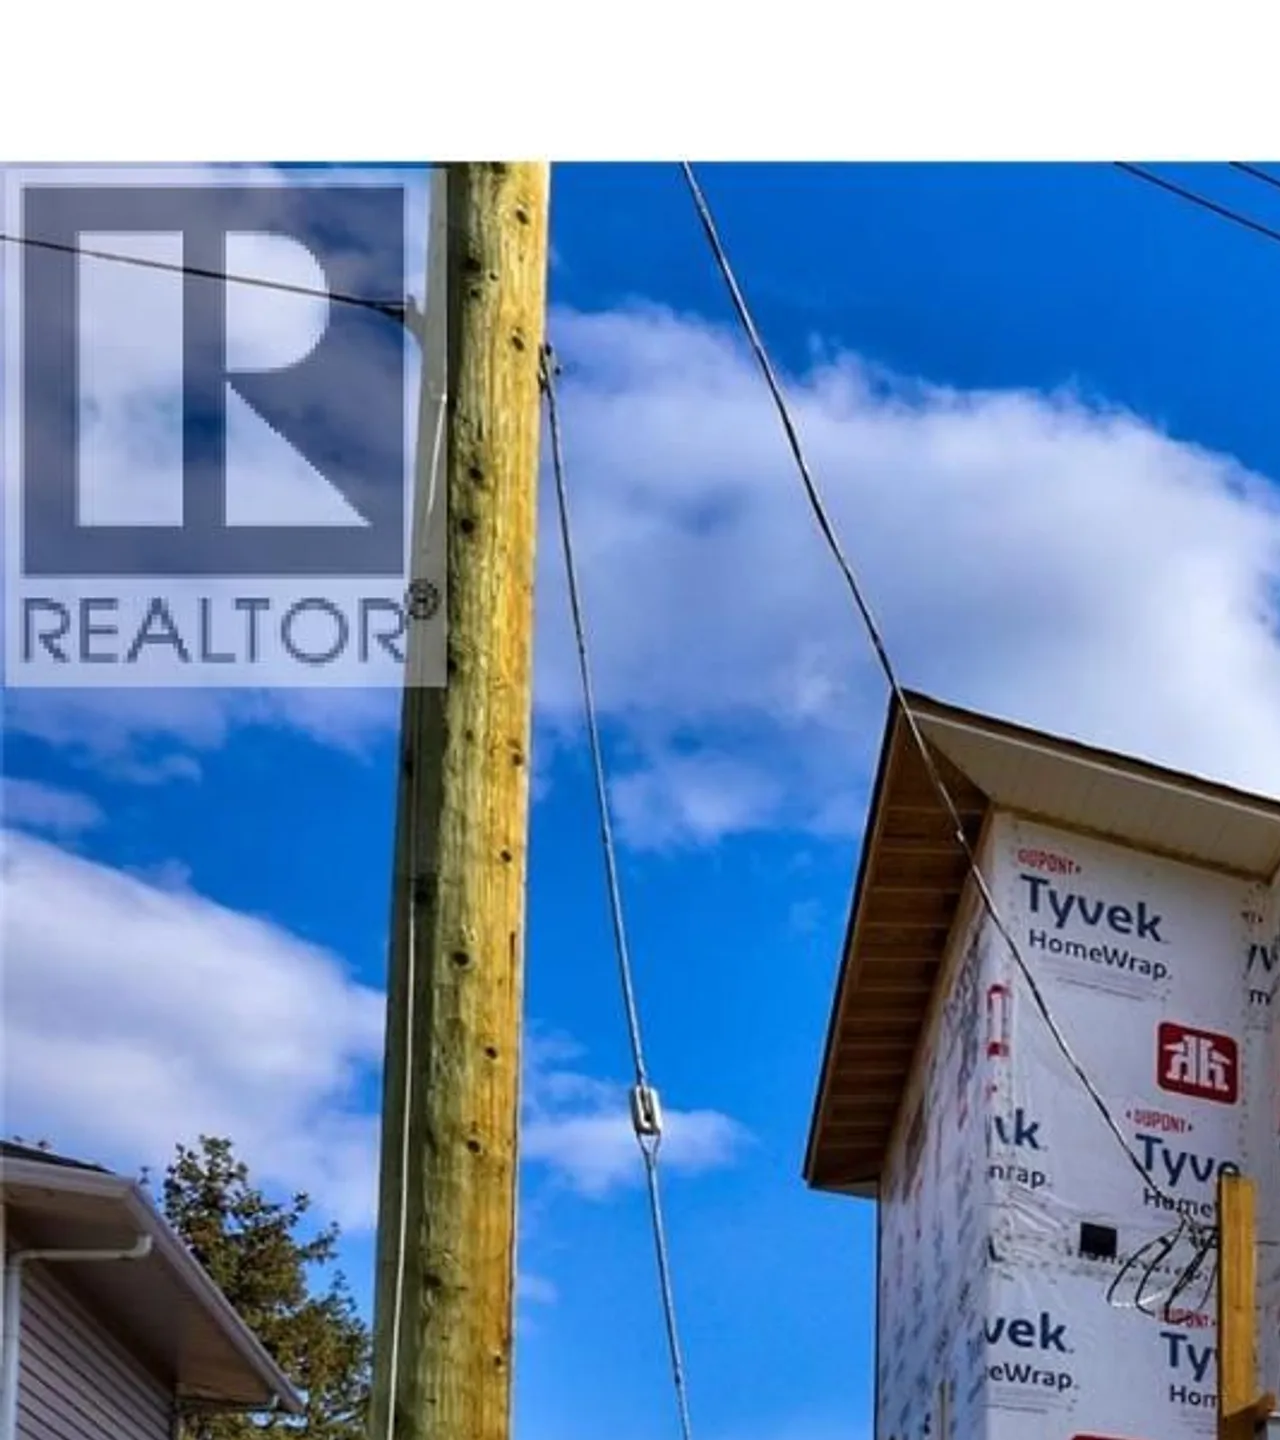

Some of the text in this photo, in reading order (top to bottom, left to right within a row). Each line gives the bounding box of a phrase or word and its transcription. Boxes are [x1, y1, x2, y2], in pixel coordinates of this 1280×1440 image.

[1020, 873, 1162, 942] Tyvek
[1029, 928, 1168, 980] HomeWrap
[1160, 1331, 1217, 1382] Ty
